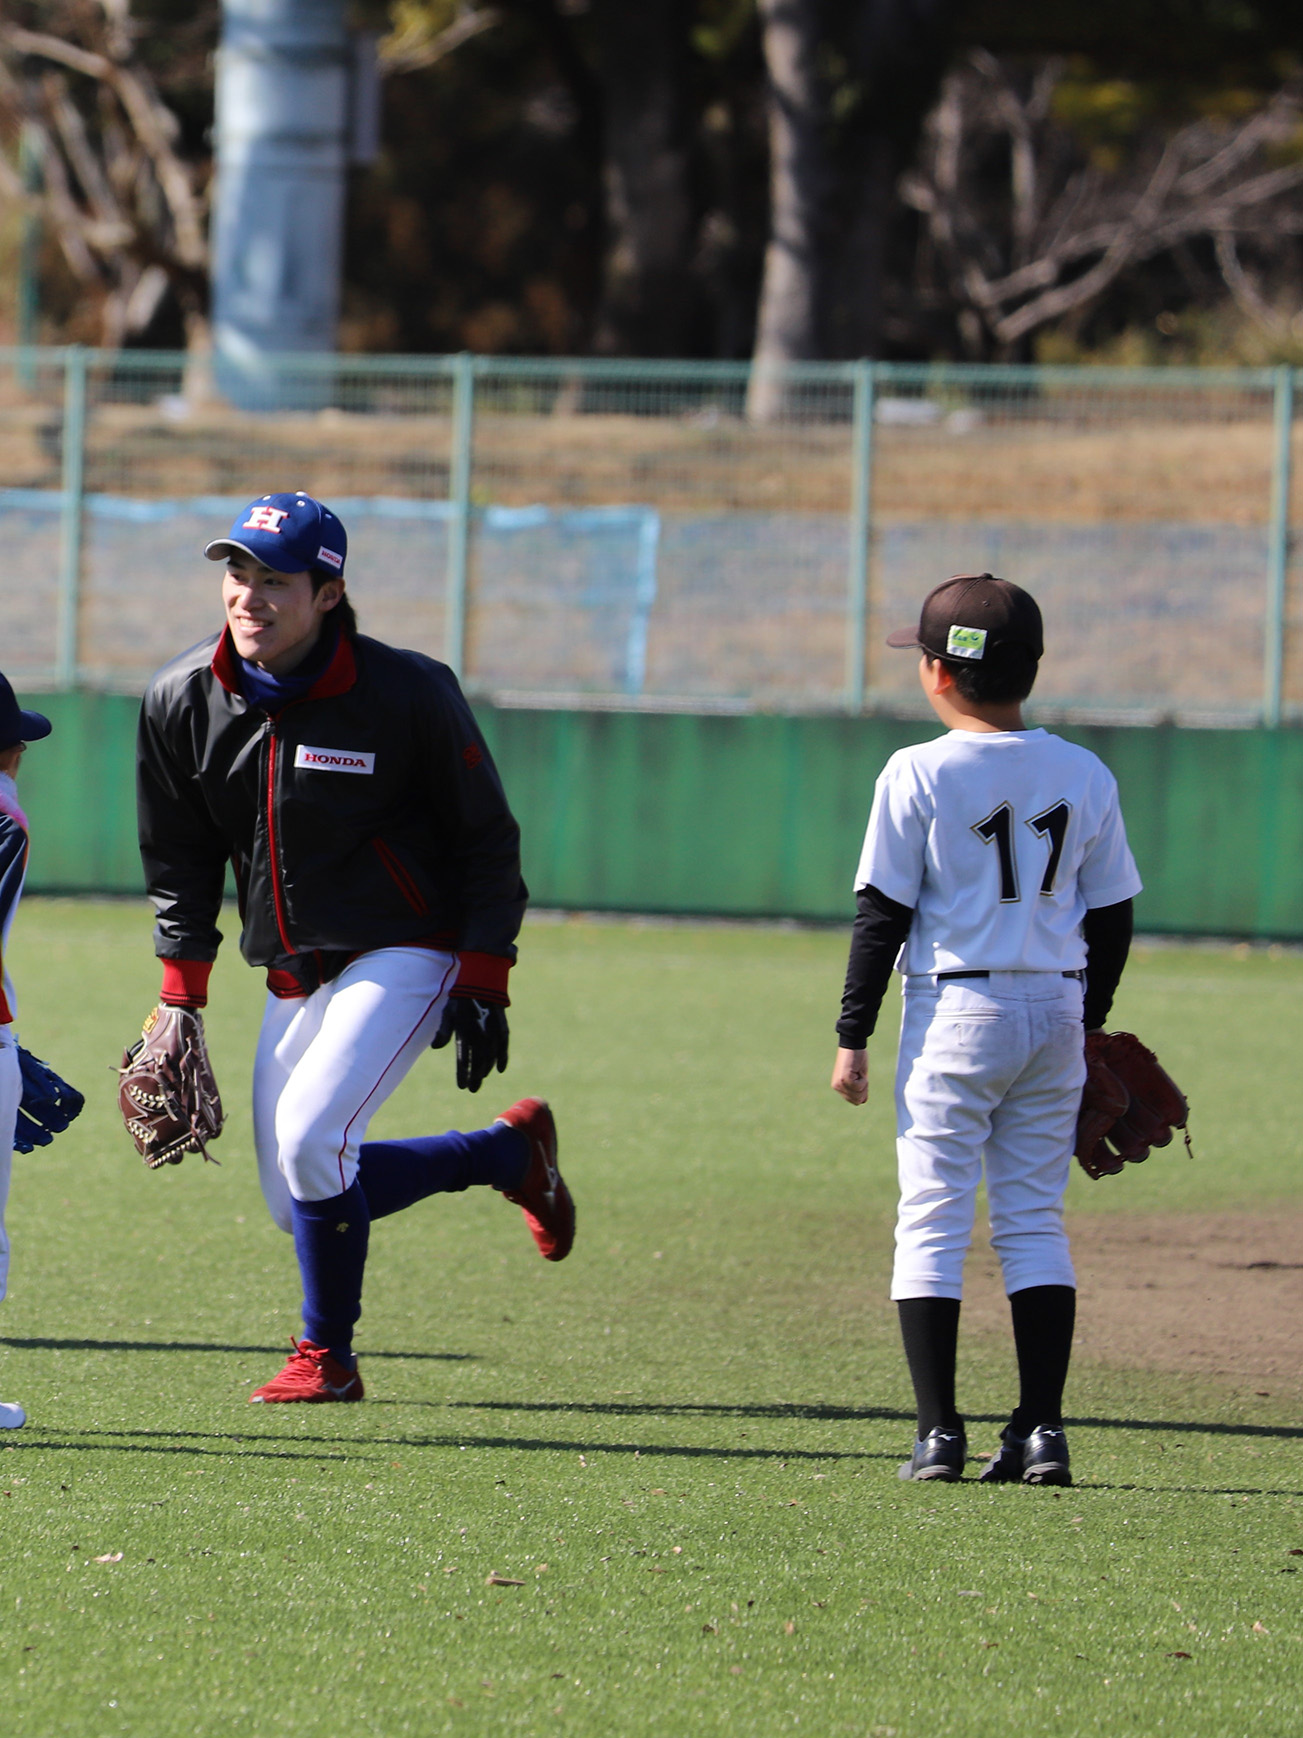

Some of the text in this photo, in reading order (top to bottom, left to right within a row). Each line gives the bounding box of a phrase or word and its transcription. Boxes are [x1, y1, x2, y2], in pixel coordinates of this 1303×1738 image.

[243, 506, 290, 534] H
[304, 753, 367, 768] HONDA
[969, 798, 1073, 904] 11
